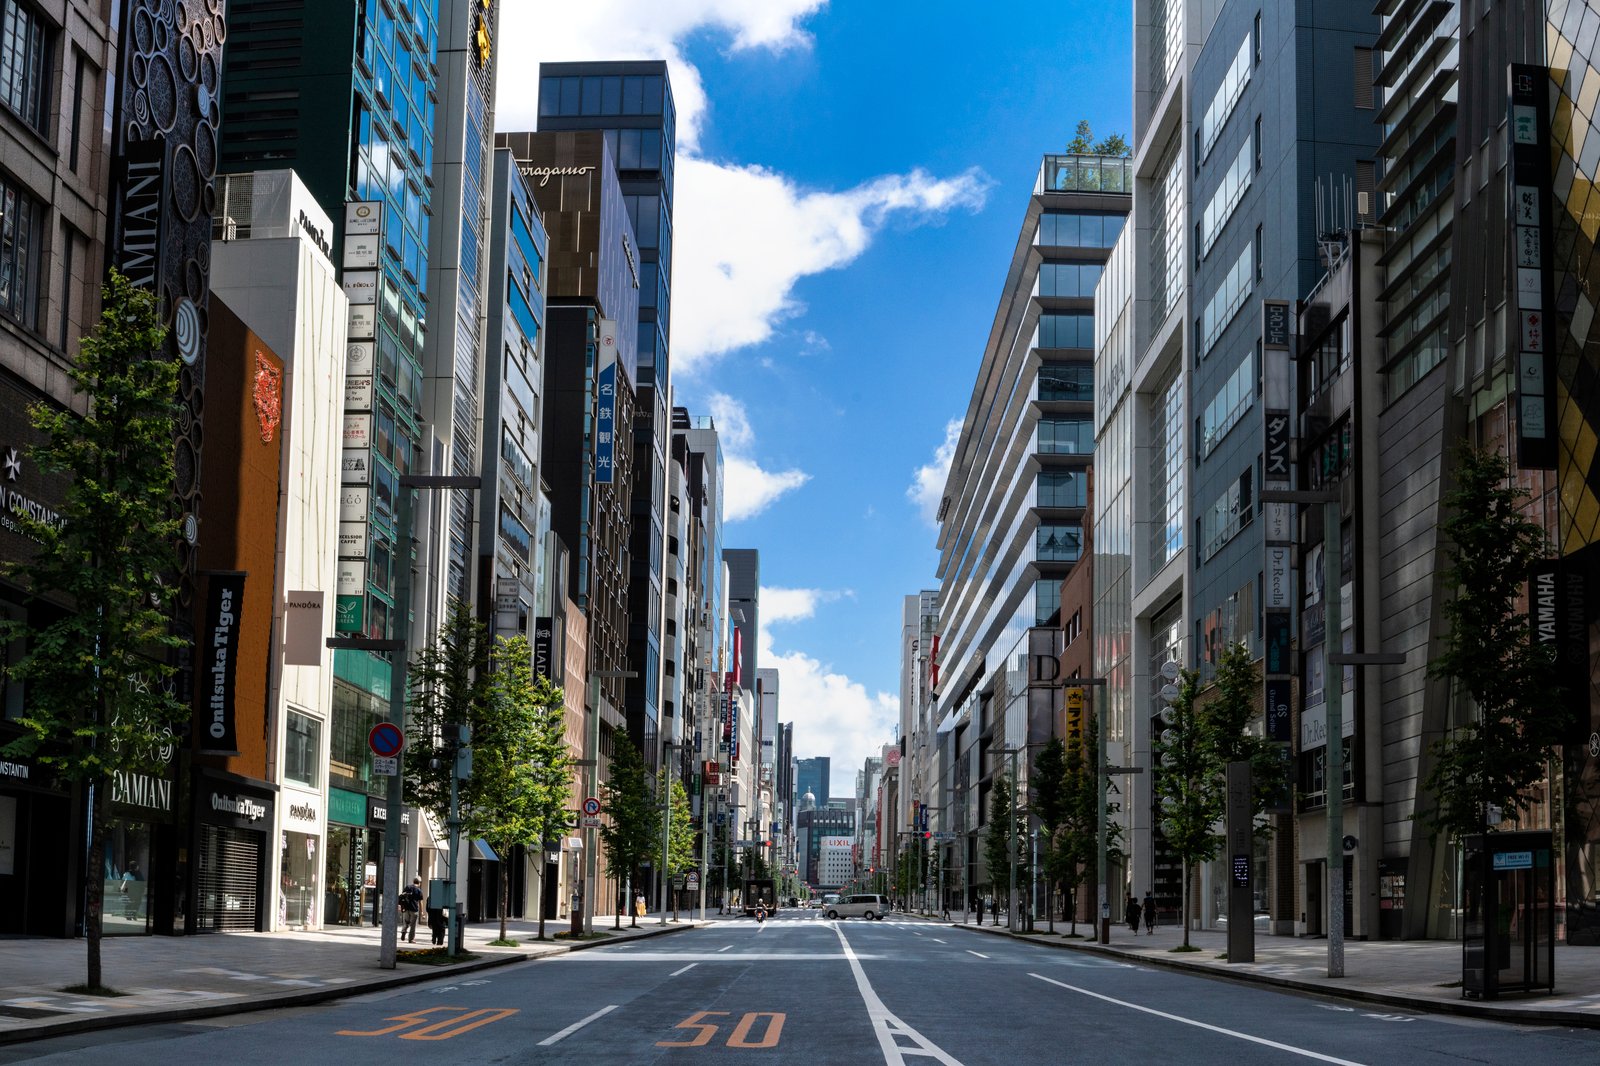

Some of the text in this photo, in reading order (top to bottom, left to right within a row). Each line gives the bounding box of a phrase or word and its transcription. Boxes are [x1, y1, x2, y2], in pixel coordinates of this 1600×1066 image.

[514, 159, 596, 188] rragamo
[122, 158, 161, 297] AMIANI
[598, 384, 613, 468] 名鉄観光
[1268, 416, 1288, 473] ダンス
[9, 491, 69, 530] CONSTANT
[1537, 573, 1555, 642] YAMAHA
[535, 643, 547, 688] LLAD
[111, 769, 172, 811] DAMIANI
[355, 837, 363, 887] EXCELSIOR
[335, 1006, 521, 1041] 50
[654, 1010, 788, 1049] 50
